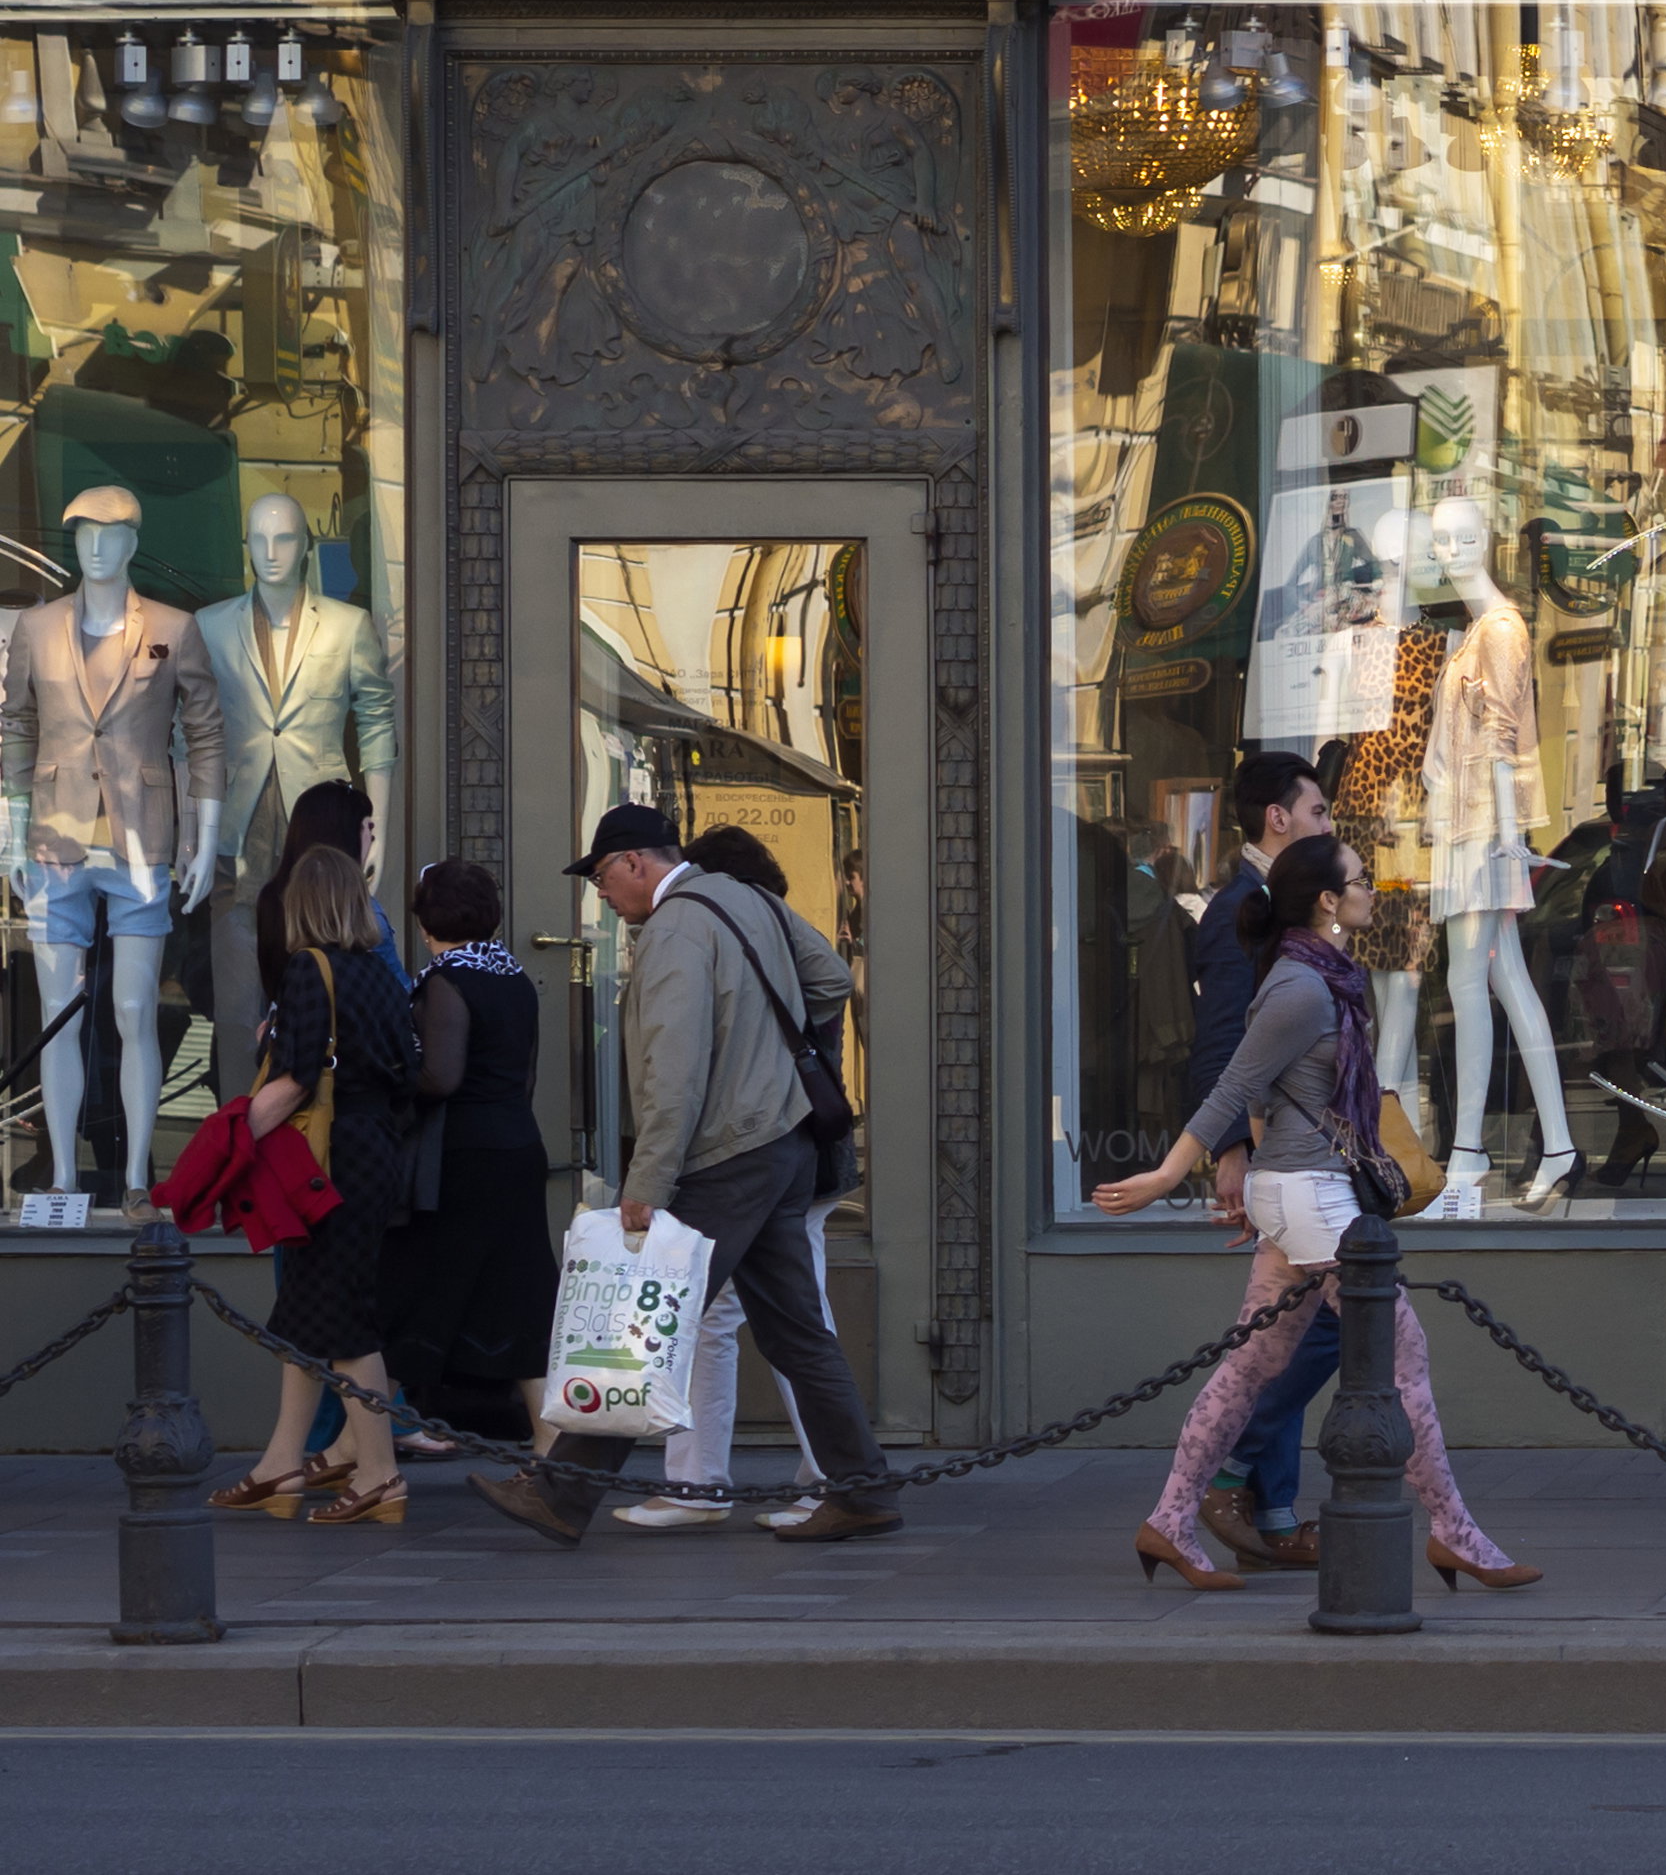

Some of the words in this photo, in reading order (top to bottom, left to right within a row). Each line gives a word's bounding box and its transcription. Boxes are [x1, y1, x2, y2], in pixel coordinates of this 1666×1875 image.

[673, 738, 745, 759] ZARA
[715, 791, 796, 803] ВОСКРЕСЕНЬЕ
[736, 808, 796, 826] 22.00
[1064, 1130, 1170, 1163] WOM
[562, 1275, 632, 1309] Bingo
[636, 1280, 661, 1312] 8
[571, 1305, 626, 1333] Slots
[550, 1305, 570, 1371] Roulette
[664, 1337, 680, 1374] Poker
[604, 1381, 652, 1412] paf
